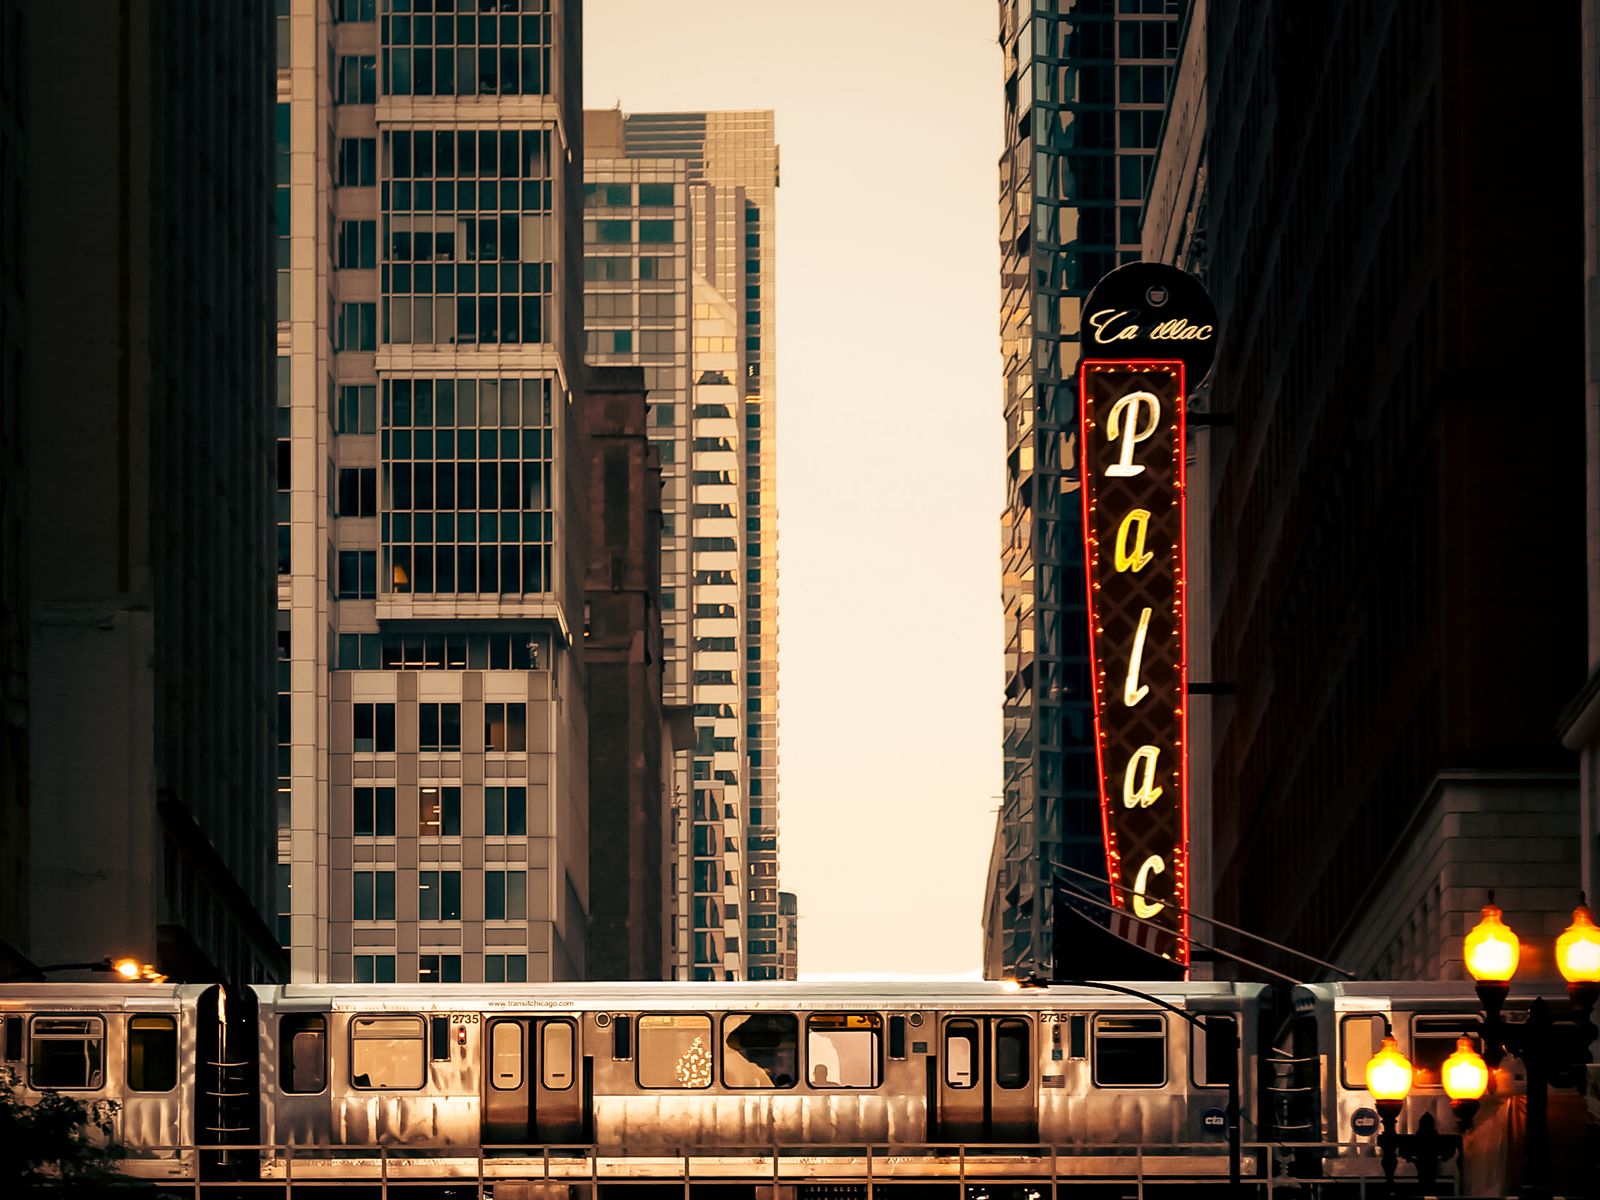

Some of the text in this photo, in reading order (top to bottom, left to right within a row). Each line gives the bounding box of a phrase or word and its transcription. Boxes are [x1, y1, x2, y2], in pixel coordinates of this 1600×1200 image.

[488, 1000, 574, 1009] www.transitchicago.com
[452, 1014, 479, 1024] 2735
[1040, 1013, 1068, 1023] 2735
[1205, 1116, 1224, 1126] cta
